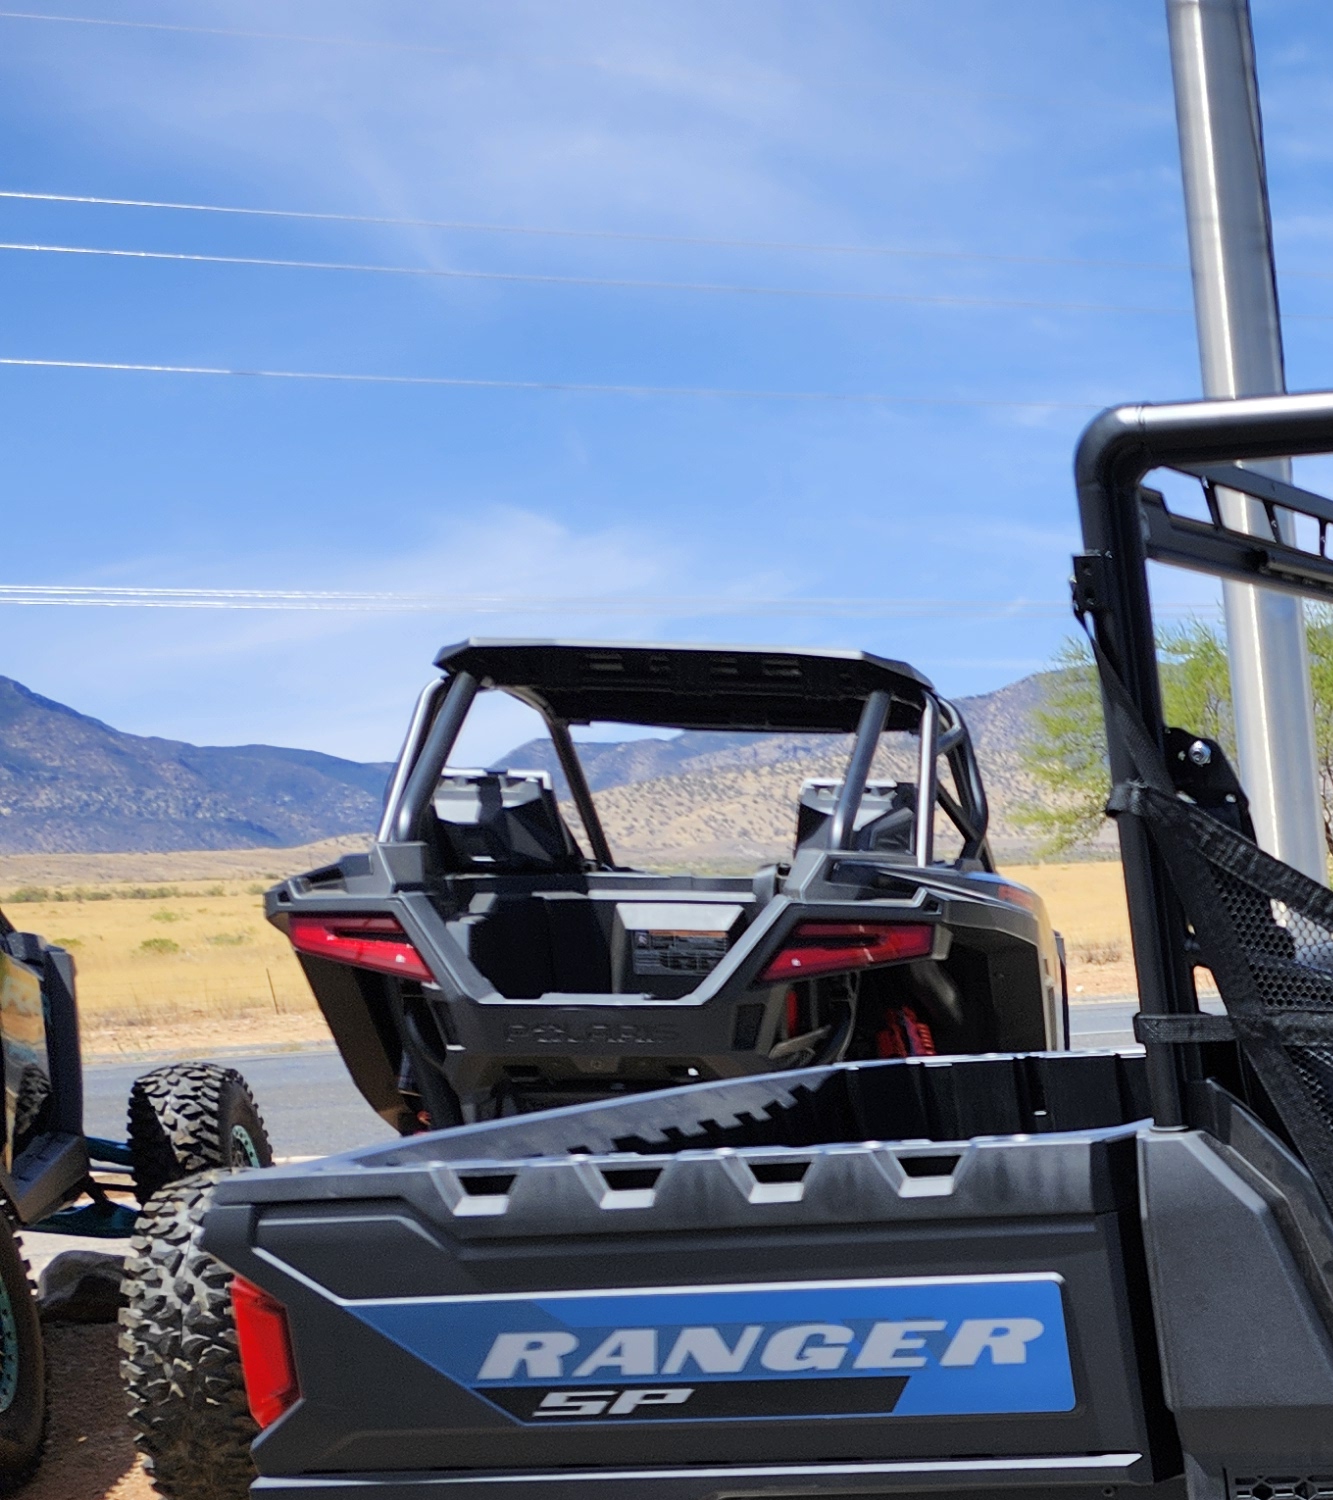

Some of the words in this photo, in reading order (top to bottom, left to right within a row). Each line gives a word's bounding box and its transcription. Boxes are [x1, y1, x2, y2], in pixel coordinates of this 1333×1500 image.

[505, 1023, 681, 1045] POLARIS
[477, 1318, 1044, 1380] RANGER
[532, 1387, 694, 1418] SP
